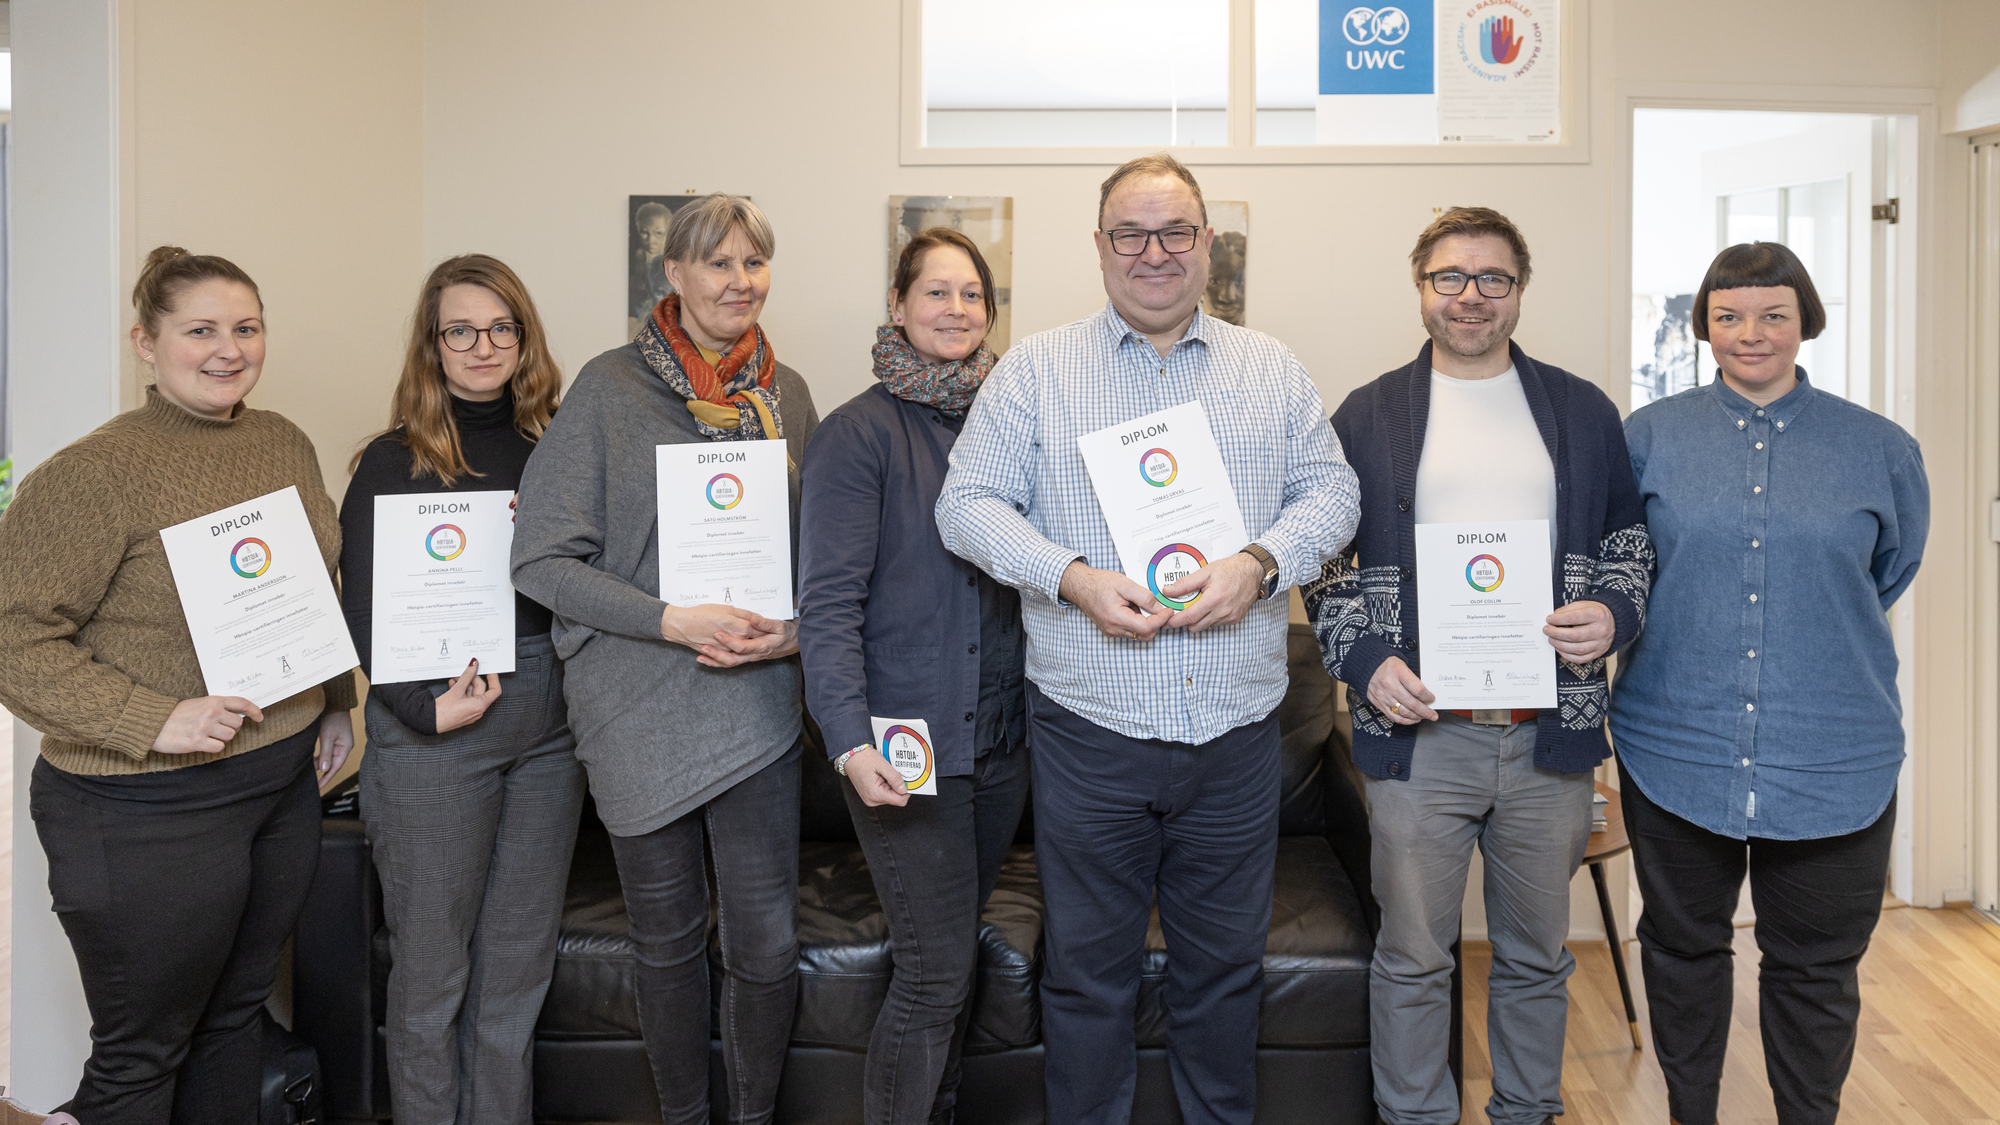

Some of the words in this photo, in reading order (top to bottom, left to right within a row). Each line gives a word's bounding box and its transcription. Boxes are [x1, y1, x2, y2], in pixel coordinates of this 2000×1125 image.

[1466, 8, 1476, 18] EI
[1457, 22, 1469, 62] RACISM!
[1532, 22, 1543, 43] MOT
[1346, 49, 1405, 70] UWC
[1513, 46, 1541, 78] RASISM!
[1467, 63, 1507, 82] AGAINST
[1120, 422, 1169, 446] DIPLOM
[698, 452, 746, 464] DIPLOM
[1152, 494, 1170, 503] TOMAS
[418, 503, 470, 515] DIPLOM
[210, 510, 263, 537] DIPLOM
[1457, 533, 1507, 544] DIPLOM
[233, 587, 257, 599] MARTINA
[257, 575, 287, 590] ANDERSSON
[895, 750, 919, 760] HBTQIA-
[895, 760, 922, 769] CERTIFIERAD
